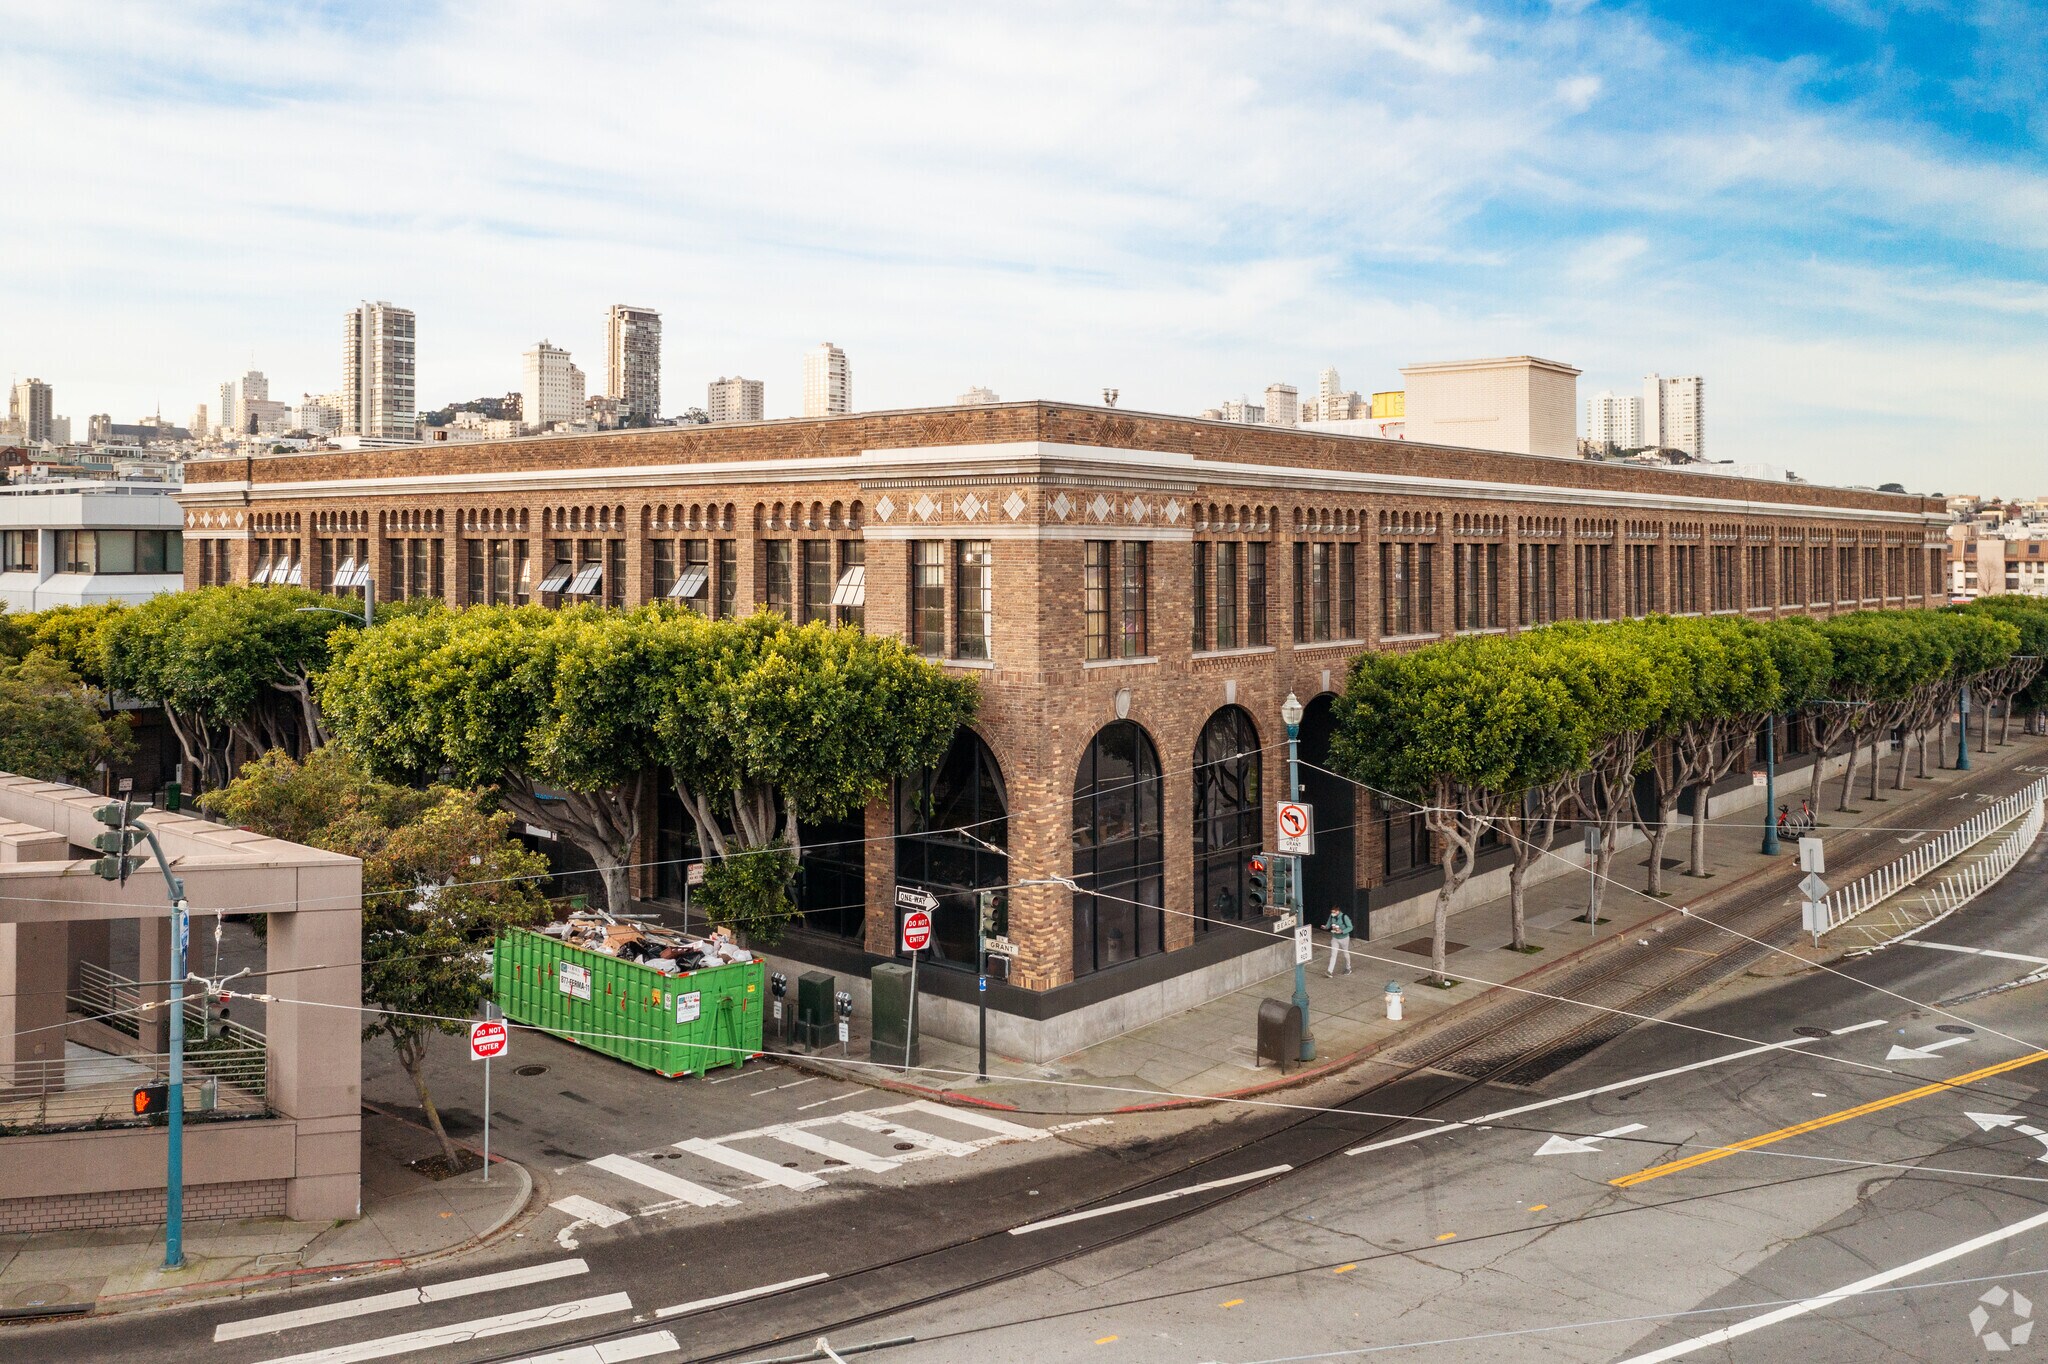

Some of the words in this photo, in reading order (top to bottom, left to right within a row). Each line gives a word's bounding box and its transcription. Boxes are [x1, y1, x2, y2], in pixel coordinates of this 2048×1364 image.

[900, 892, 912, 902] ONE
[914, 896, 926, 905] WAY
[918, 918, 928, 926] NOT
[1276, 917, 1295, 930] BEACH
[1299, 929, 1308, 937] NO
[909, 935, 925, 943] ENTER
[990, 941, 1014, 953] GRANT
[476, 1029, 486, 1037] DO
[488, 1026, 502, 1035] NOT
[479, 1042, 499, 1052] ENTER
